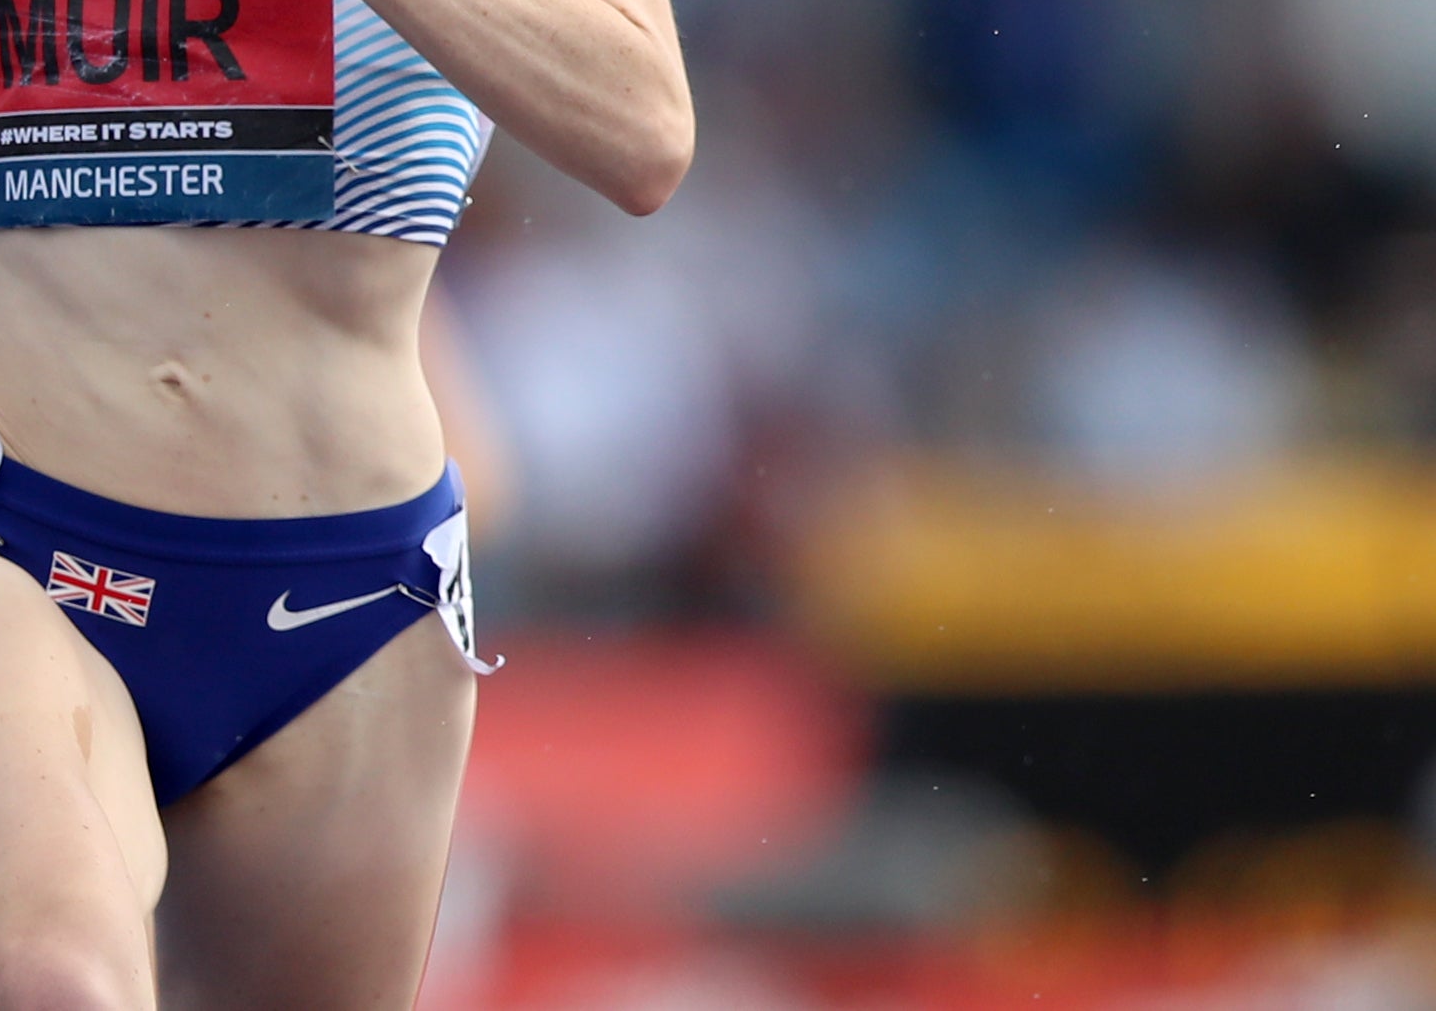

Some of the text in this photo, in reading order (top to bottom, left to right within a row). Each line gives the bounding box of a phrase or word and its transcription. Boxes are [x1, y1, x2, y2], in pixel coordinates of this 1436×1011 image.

[0, 121, 234, 146] #WHERE IT STARTS
[4, 164, 225, 202] MANCHESTER
